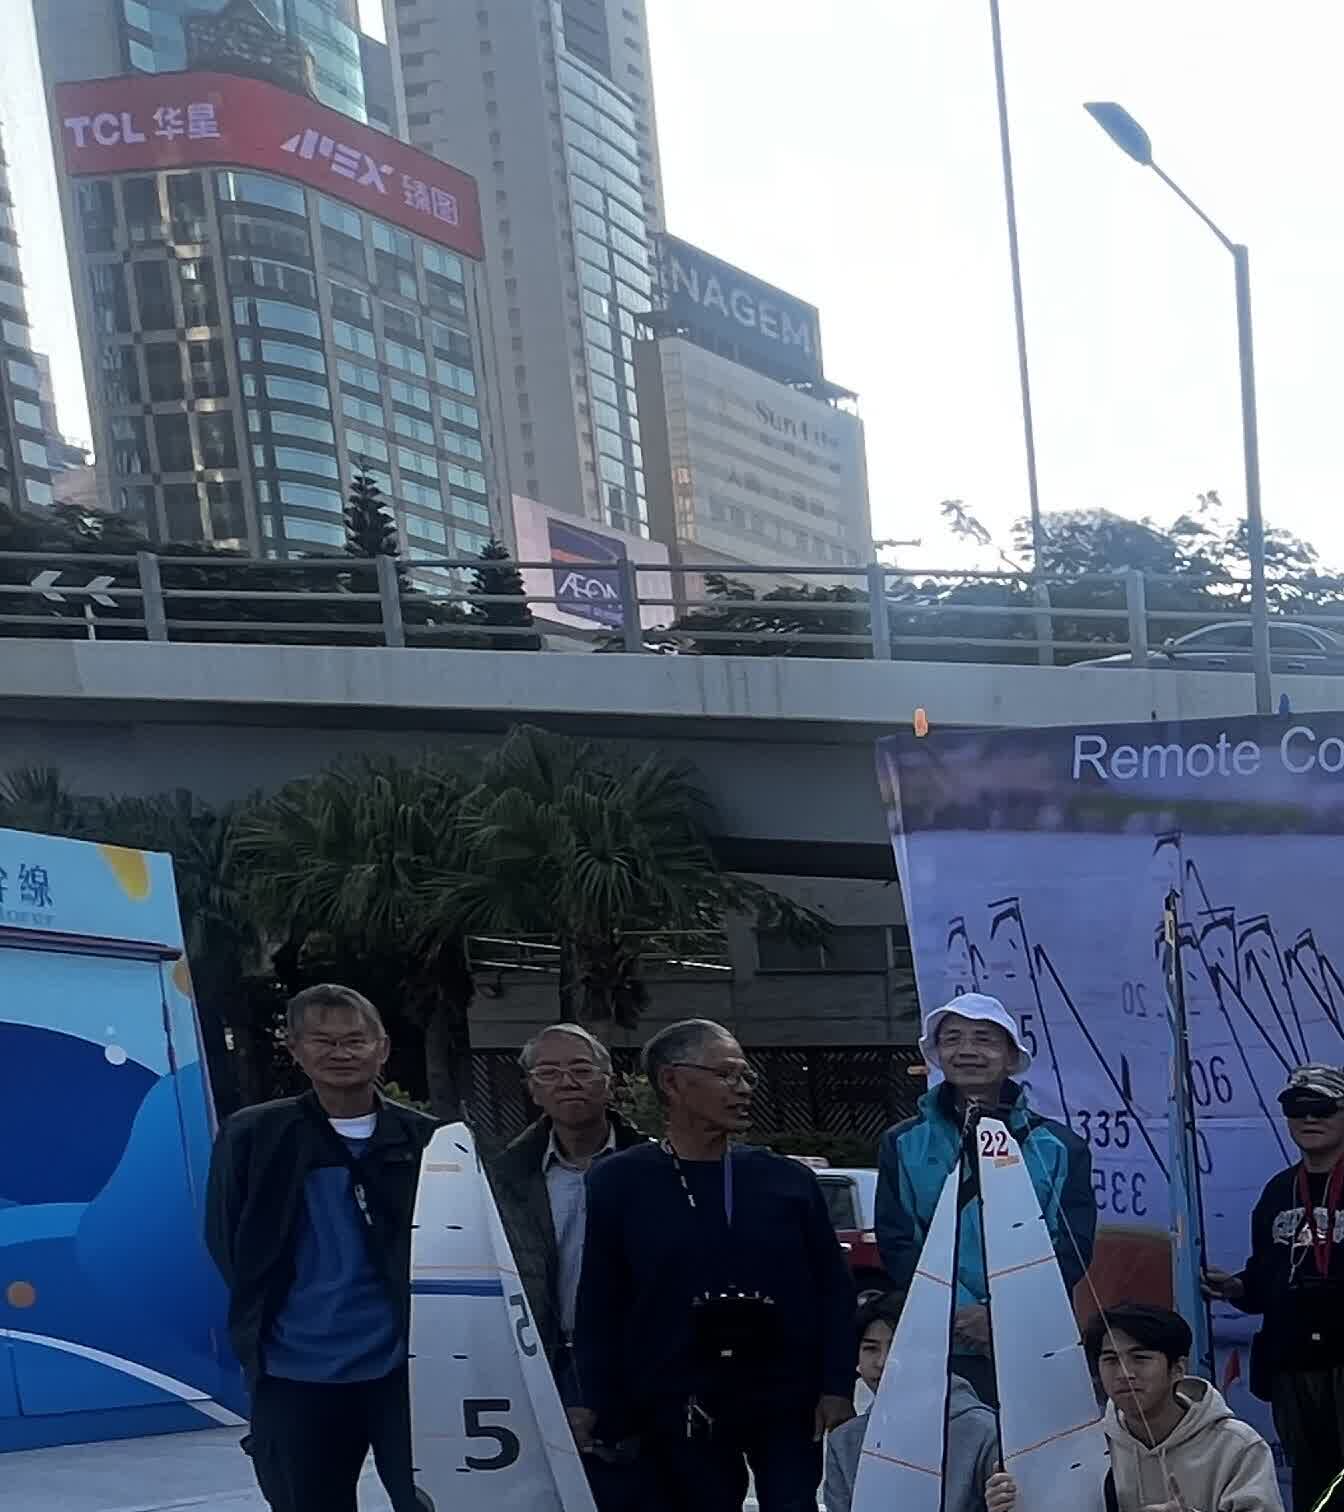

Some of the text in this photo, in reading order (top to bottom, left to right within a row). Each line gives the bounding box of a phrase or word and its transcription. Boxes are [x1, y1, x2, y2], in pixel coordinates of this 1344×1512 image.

[64, 103, 221, 147] TCL 华星
[1072, 732, 1261, 780] Remote
[979, 1129, 1010, 1157] 22
[1077, 1110, 1130, 1149] 335
[461, 1398, 521, 1472] 5
